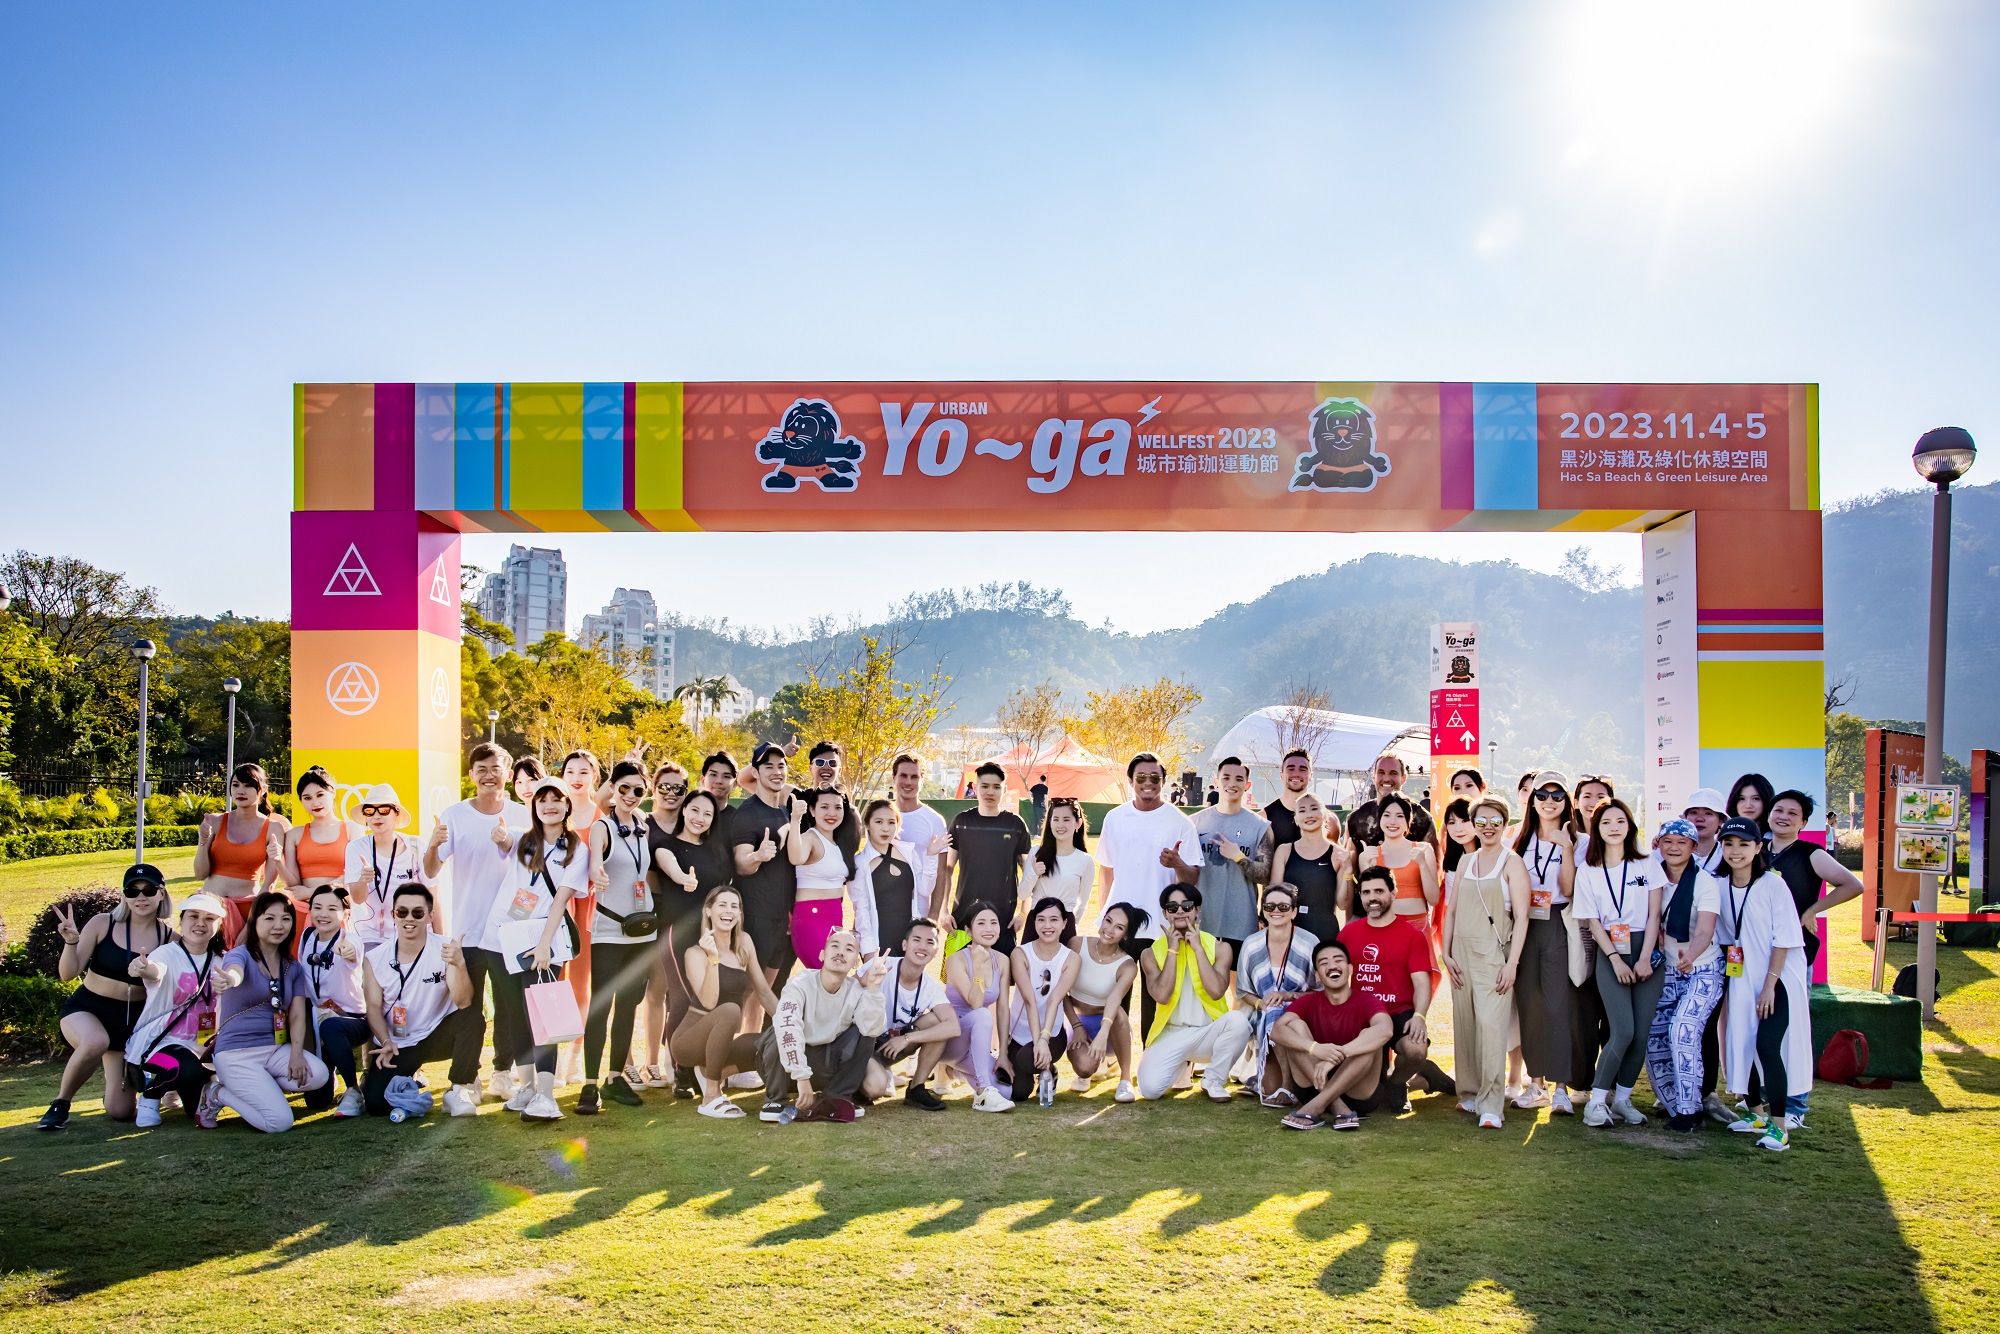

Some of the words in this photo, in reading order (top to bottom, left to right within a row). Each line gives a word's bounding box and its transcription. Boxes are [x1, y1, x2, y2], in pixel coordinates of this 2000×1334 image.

[939, 402, 988, 415] URBAN
[1559, 412, 1767, 439] 2023.11.4-5
[1138, 435, 1214, 449] WELLFEST
[1218, 428, 1277, 449] 2023
[1137, 454, 1279, 474] 城市瑜珈運動節
[1560, 450, 1768, 469] 黑沙海灘及綠化休憩空間
[1560, 471, 1583, 482] Hac
[1586, 471, 1601, 482] Sa
[1604, 471, 1641, 482] Beach
[1644, 471, 1653, 482] &
[1656, 471, 1692, 482] Green
[1695, 471, 1738, 482] Leisure
[1740, 471, 1768, 482] Area
[1358, 964, 1380, 972] KEEP
[1356, 973, 1381, 982] CALM
[1373, 993, 1396, 1002] OUR
